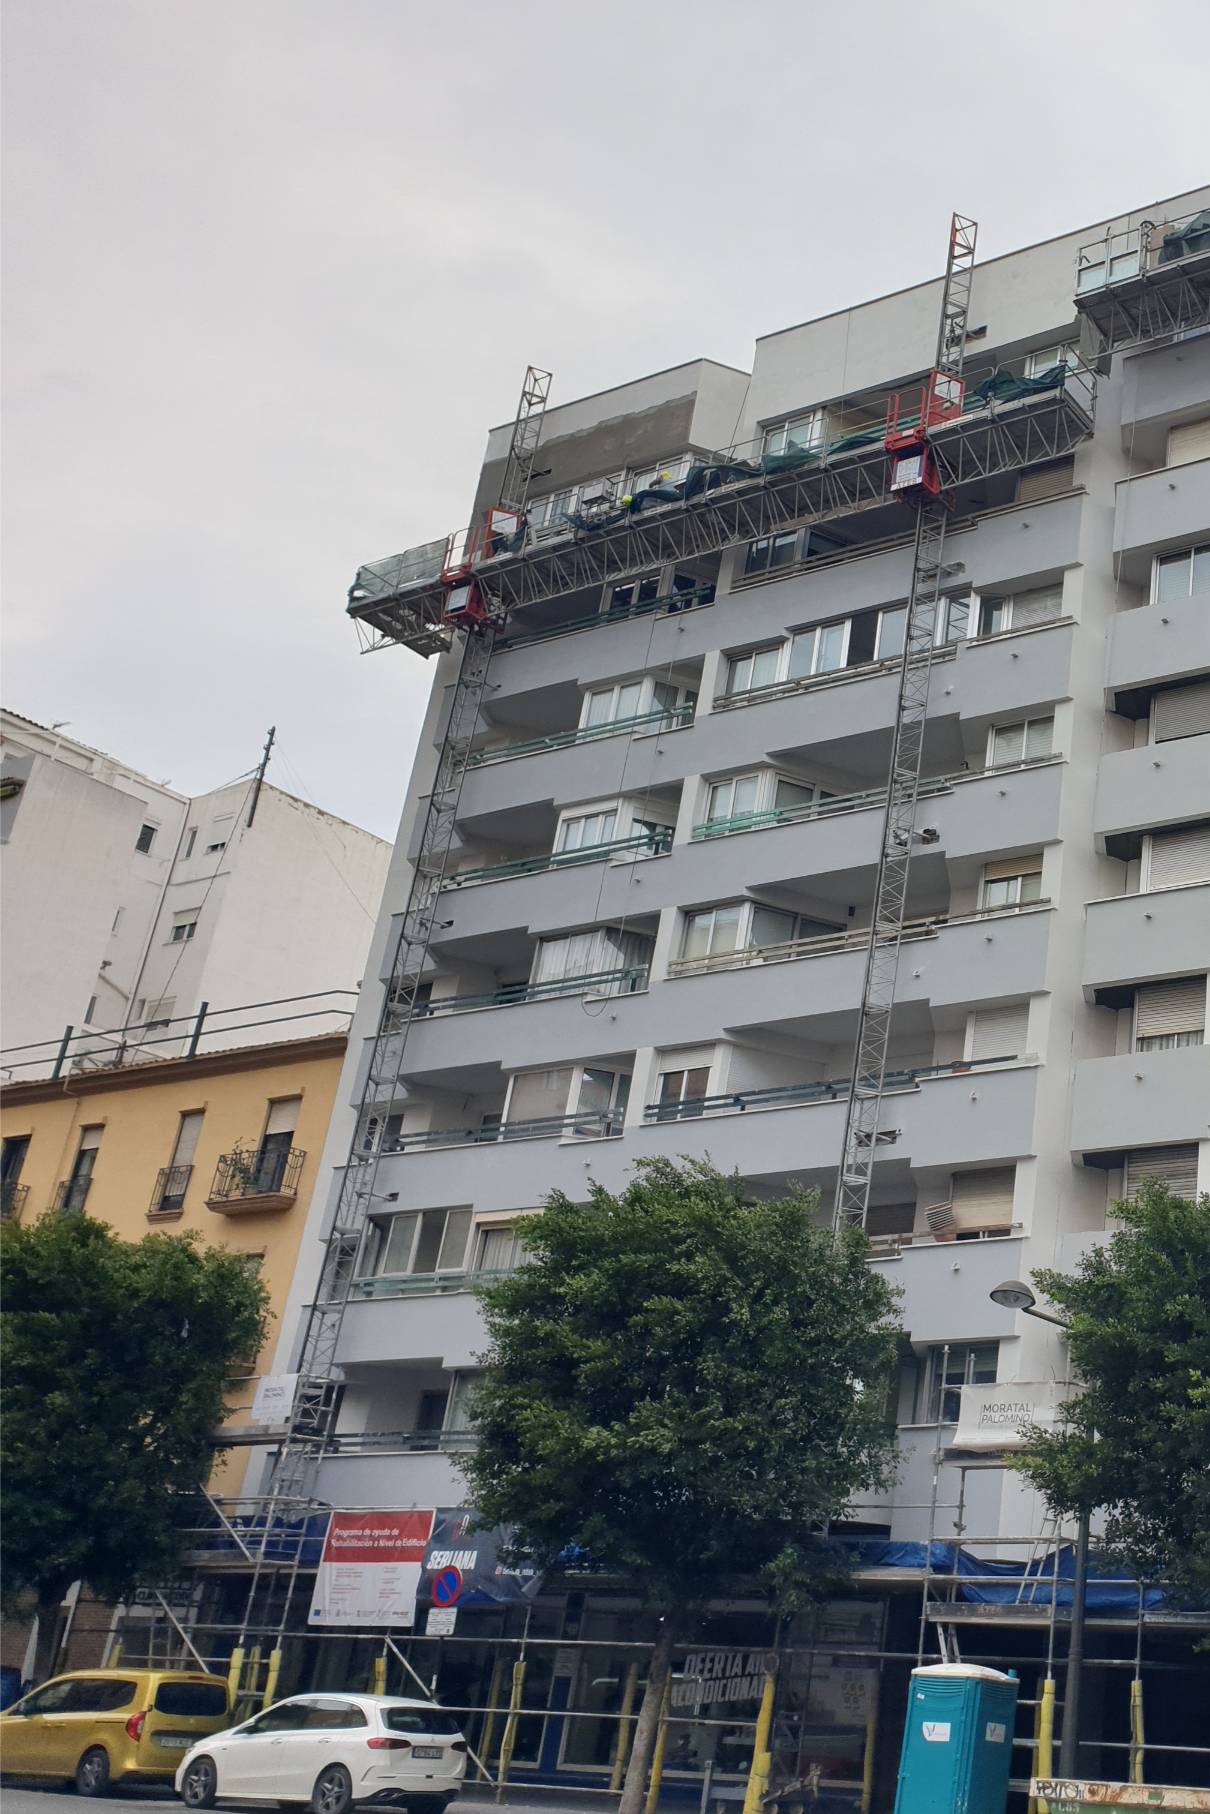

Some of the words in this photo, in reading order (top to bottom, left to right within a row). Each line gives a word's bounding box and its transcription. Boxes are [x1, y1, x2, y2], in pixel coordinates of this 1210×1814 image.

[983, 1403, 1031, 1413] MORATAL
[981, 1414, 1031, 1424] PALOMINO
[334, 1528, 362, 1537] Programa
[372, 1528, 390, 1537] ayuda
[391, 1528, 399, 1536] de
[379, 1539, 394, 1547] Nivel
[402, 1538, 427, 1547] Edificio
[683, 1652, 744, 1679] OFERTA
